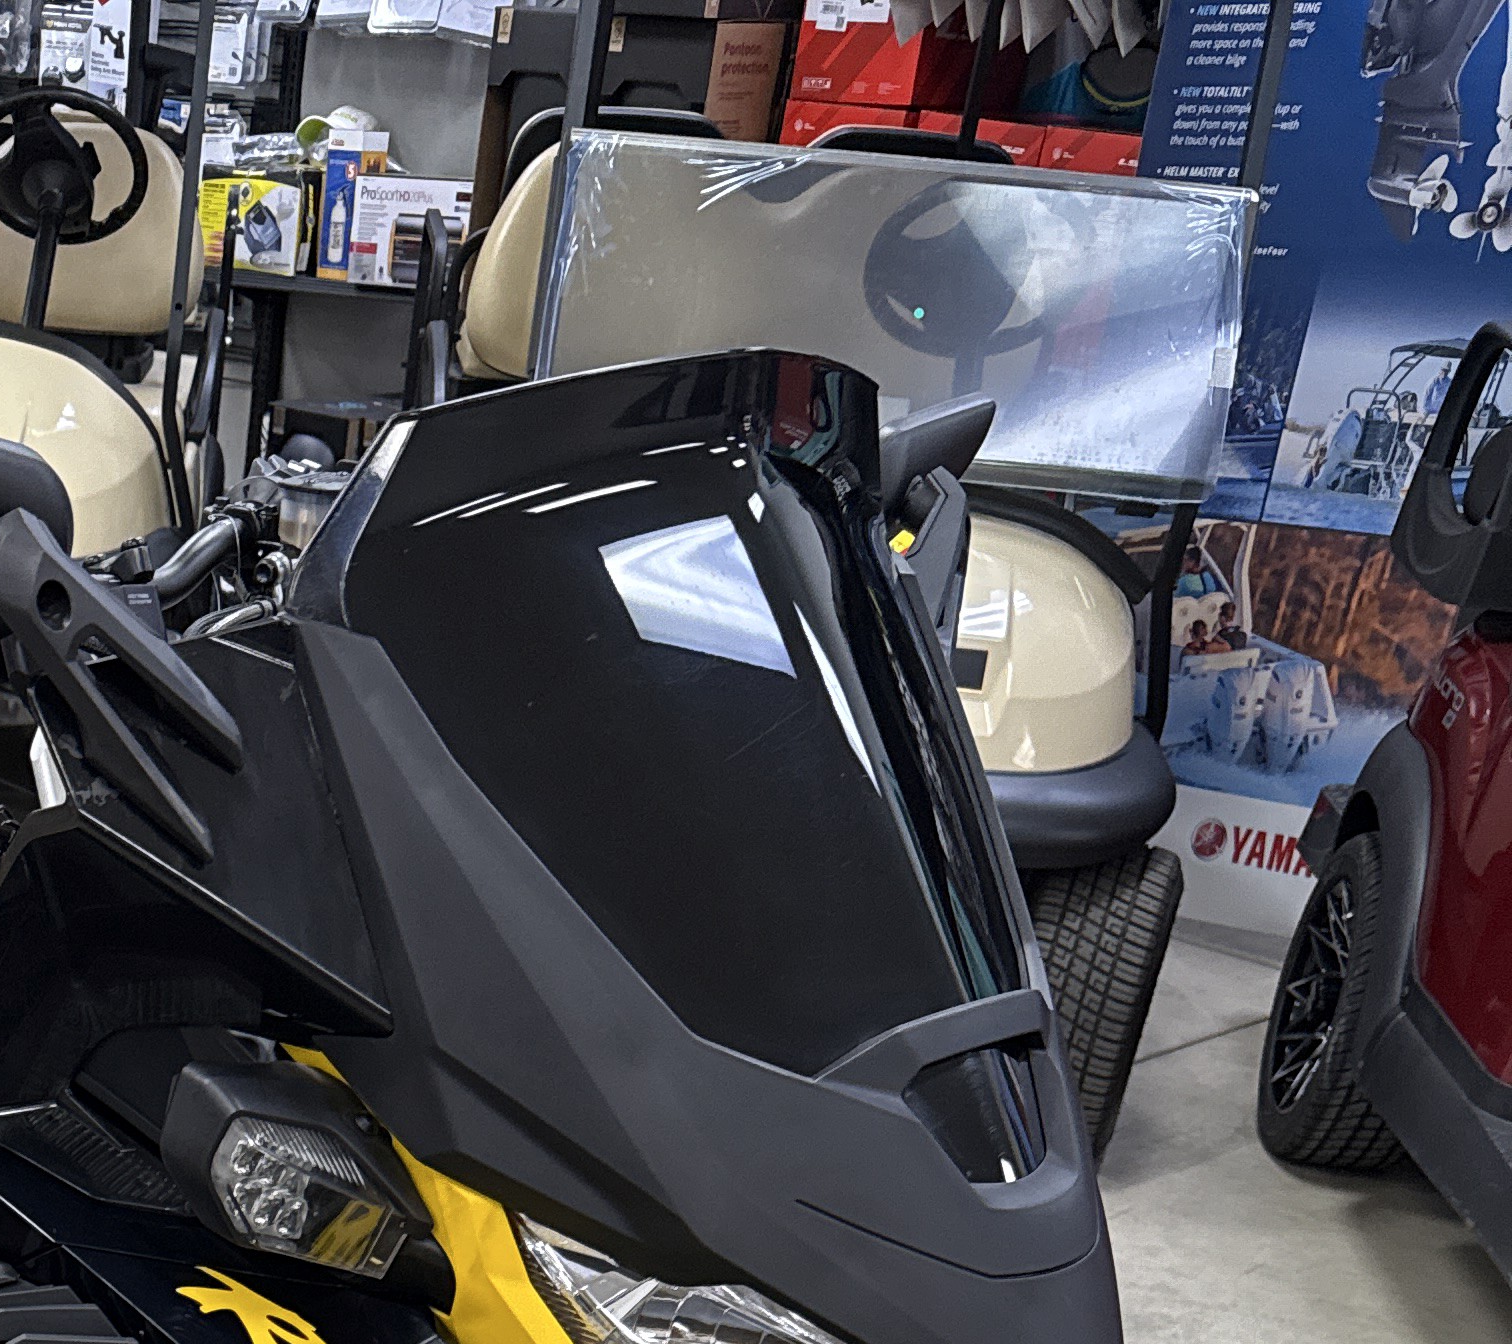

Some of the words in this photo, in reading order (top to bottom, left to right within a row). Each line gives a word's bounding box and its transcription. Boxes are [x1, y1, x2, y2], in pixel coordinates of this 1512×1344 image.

[1196, 4, 1220, 16] NEW
[1219, 3, 1270, 16] INTEGRATE
[1292, 2, 1322, 14] ERING
[1191, 20, 1229, 35] provides
[1189, 39, 1213, 49] more
[1213, 39, 1238, 51] space
[1239, 39, 1251, 48] on
[1186, 55, 1194, 66] a
[1194, 53, 1225, 66] cleaner
[1225, 53, 1247, 68] bilge
[721, 62, 769, 77] protection
[1180, 86, 1202, 98] NEW
[1175, 102, 1197, 116] gives
[1196, 104, 1214, 116] you
[1215, 104, 1222, 114] a
[1198, 118, 1221, 132] from
[1221, 121, 1238, 133] any
[1170, 134, 1184, 146] the
[1184, 134, 1209, 146] touch
[1209, 134, 1220, 149] of
[1219, 136, 1226, 146] a
[1227, 135, 1246, 146] butt
[1163, 165, 1189, 177] HELM
